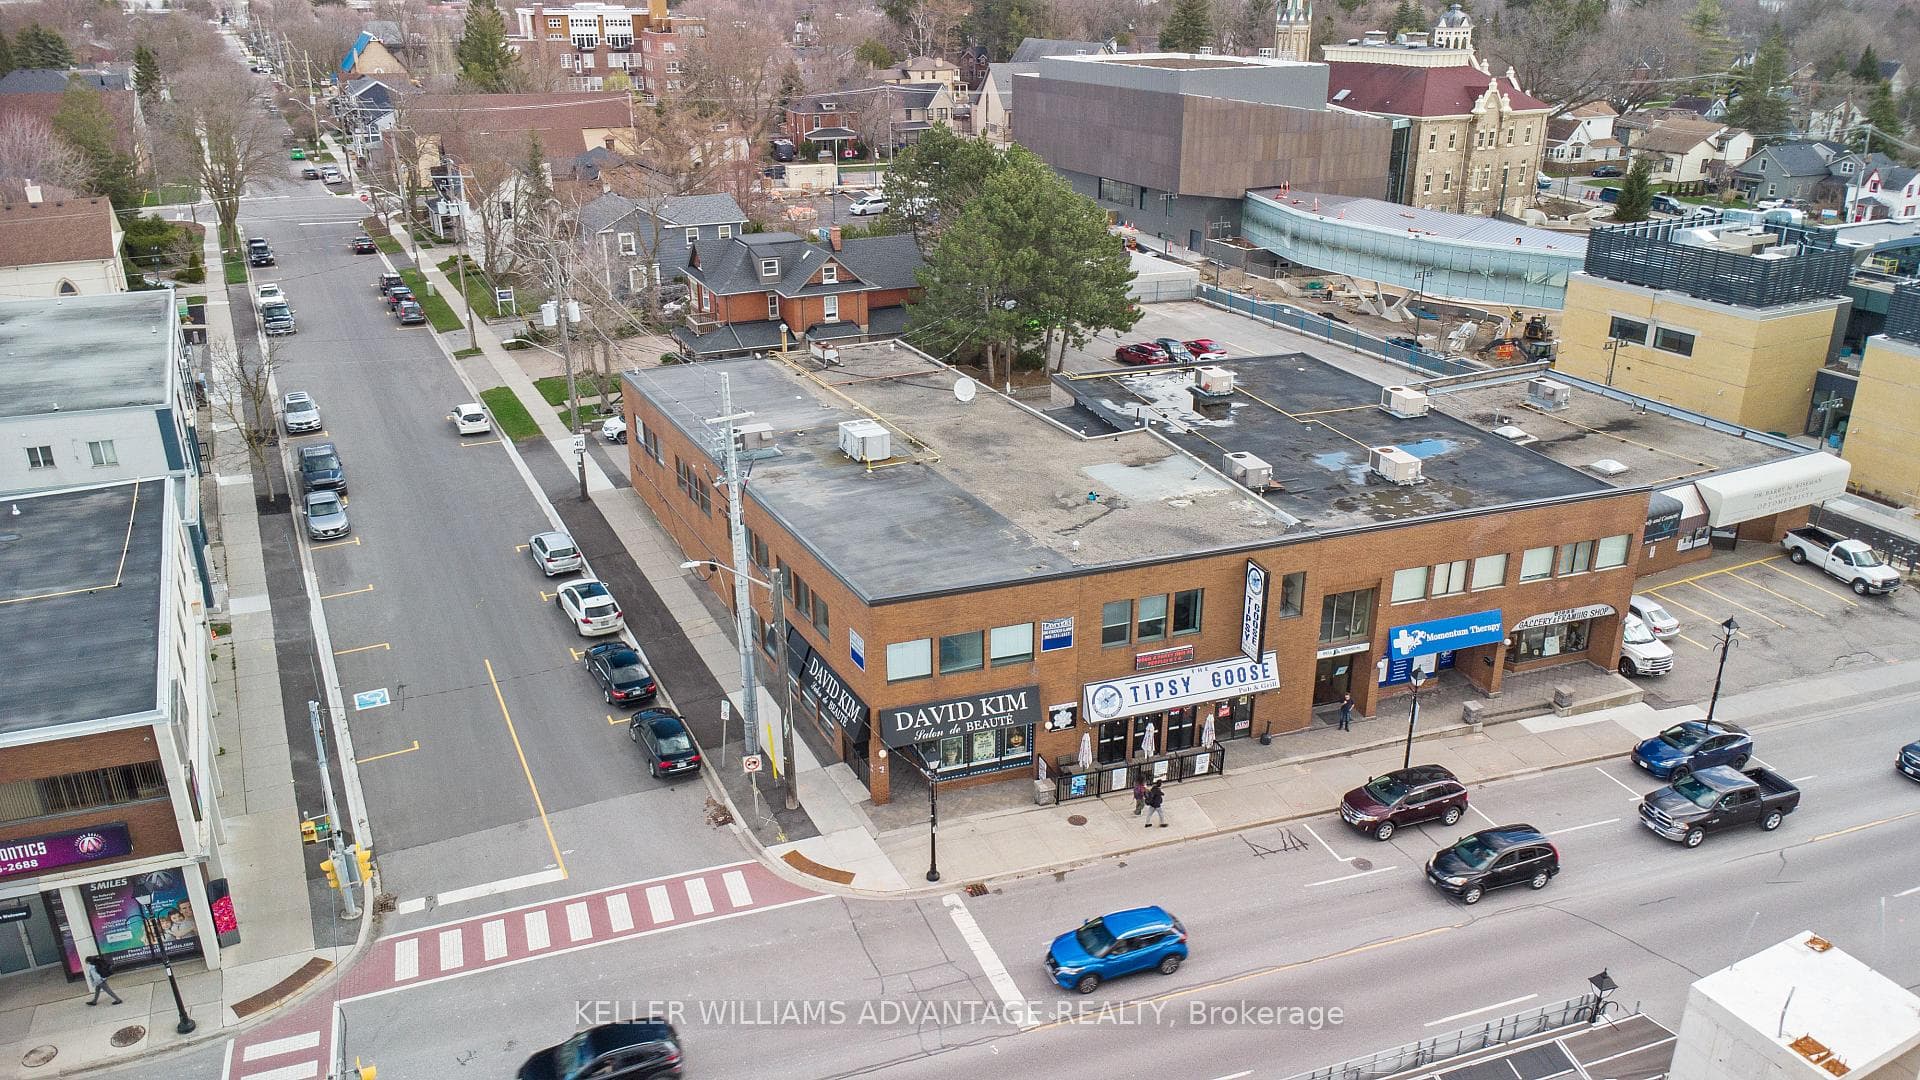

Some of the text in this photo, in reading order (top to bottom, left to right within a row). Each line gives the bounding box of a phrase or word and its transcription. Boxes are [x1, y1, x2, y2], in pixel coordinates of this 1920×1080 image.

[1244, 595, 1253, 641] TIPSY
[1252, 603, 1260, 646] GOOSE
[1589, 606, 1609, 618] SHOP
[1426, 622, 1502, 641] Momentum Therapy
[1130, 662, 1271, 703] TIPSY GOOSE
[1191, 666, 1209, 674] THE
[809, 657, 840, 699] DAVID
[838, 688, 862, 724] KIM
[894, 691, 1029, 732] DAVID KIM
[914, 713, 1014, 741] Salon de BEAUTÉ
[90, 878, 128, 892] SMILES
